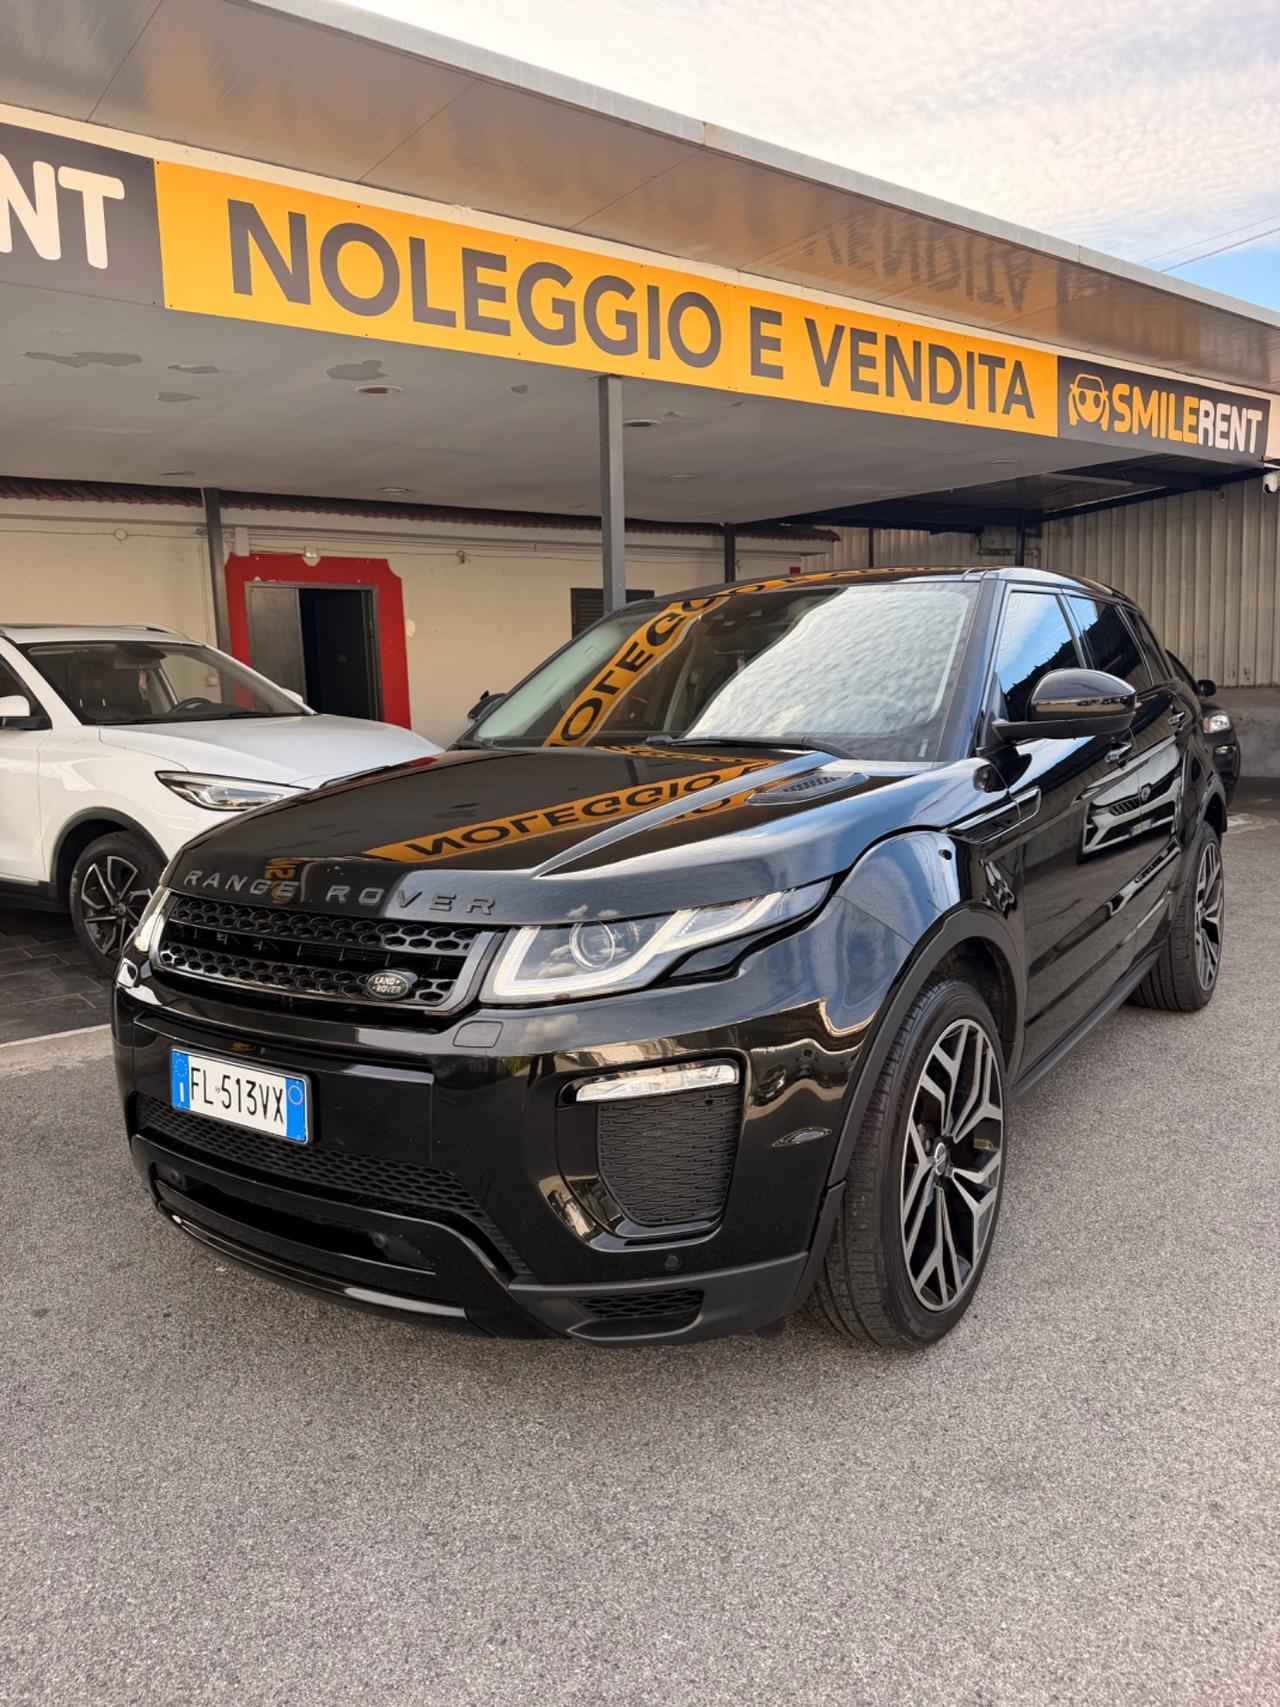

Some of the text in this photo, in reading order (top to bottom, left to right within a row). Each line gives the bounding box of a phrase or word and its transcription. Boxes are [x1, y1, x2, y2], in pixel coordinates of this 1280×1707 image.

[227, 198, 722, 368] NOLEGGIO
[749, 306, 784, 380] E
[805, 318, 1035, 419] VENDITA
[183, 870, 496, 915] RANGE ROVER
[374, 976, 396, 985] LAND
[375, 984, 402, 993] ROVER
